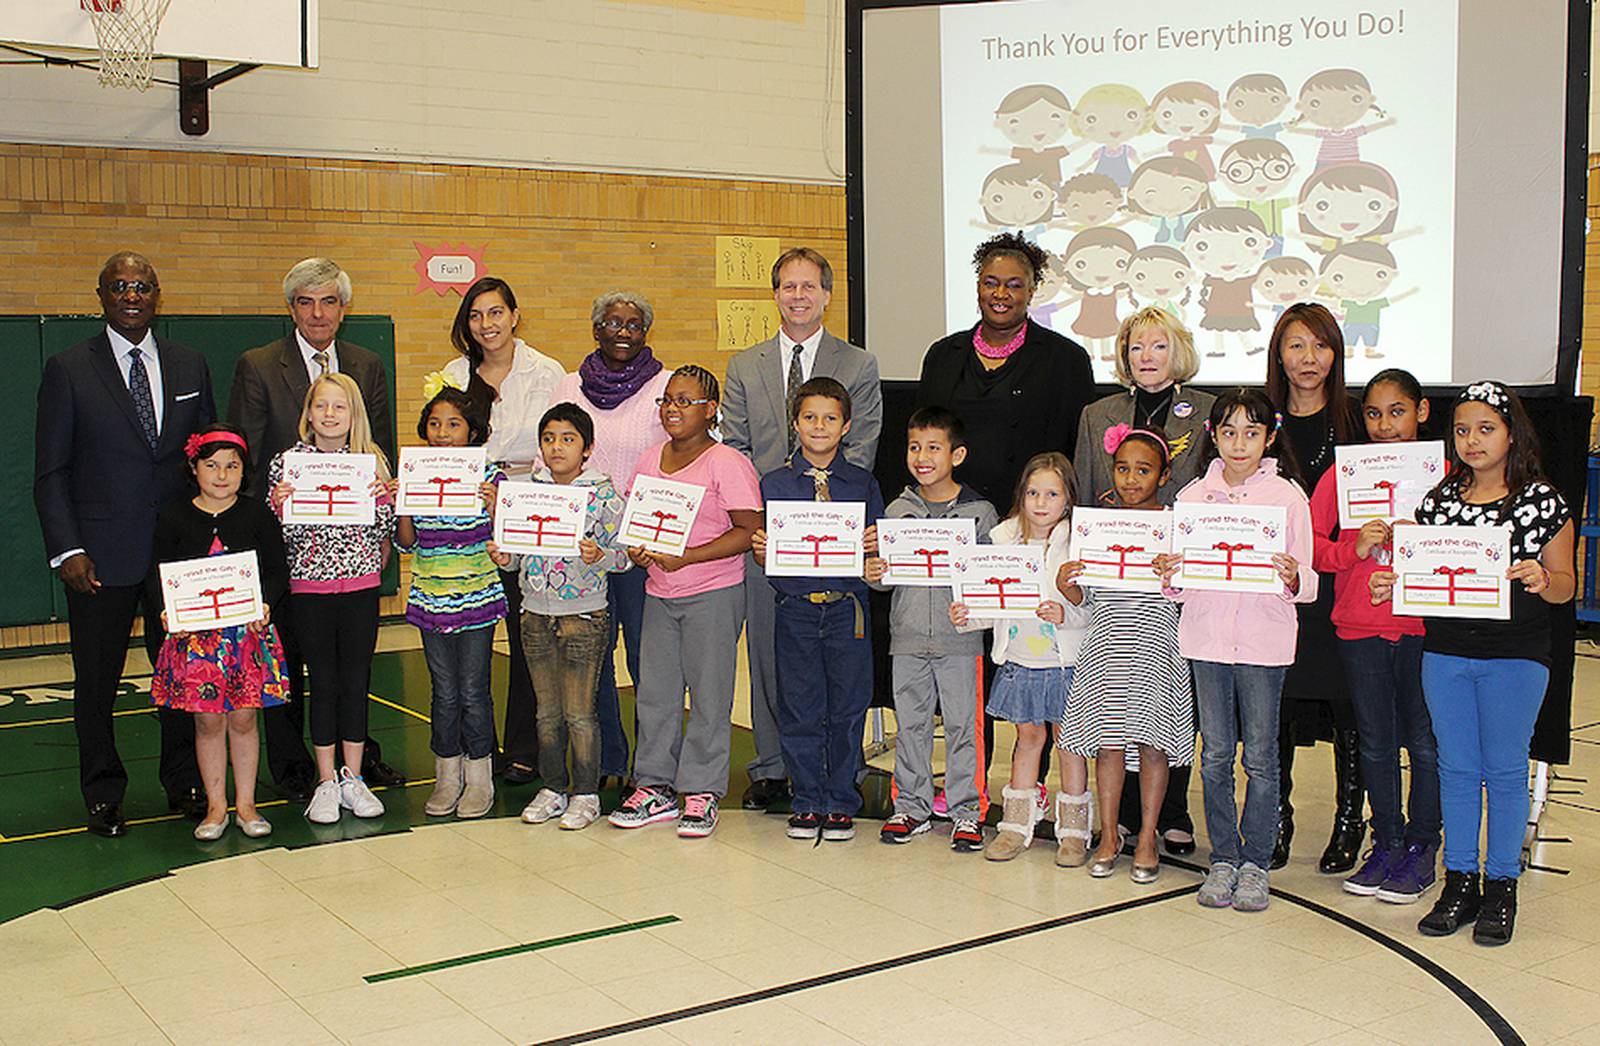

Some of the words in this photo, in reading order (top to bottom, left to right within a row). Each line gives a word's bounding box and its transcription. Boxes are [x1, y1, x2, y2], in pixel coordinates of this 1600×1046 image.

[982, 33, 1055, 60] Thank
[1062, 32, 1105, 56] You
[1113, 28, 1148, 52] for
[1157, 19, 1294, 52] Everything
[1300, 15, 1347, 40] You
[1357, 9, 1405, 36] Do!
[440, 263, 463, 274] Fun!
